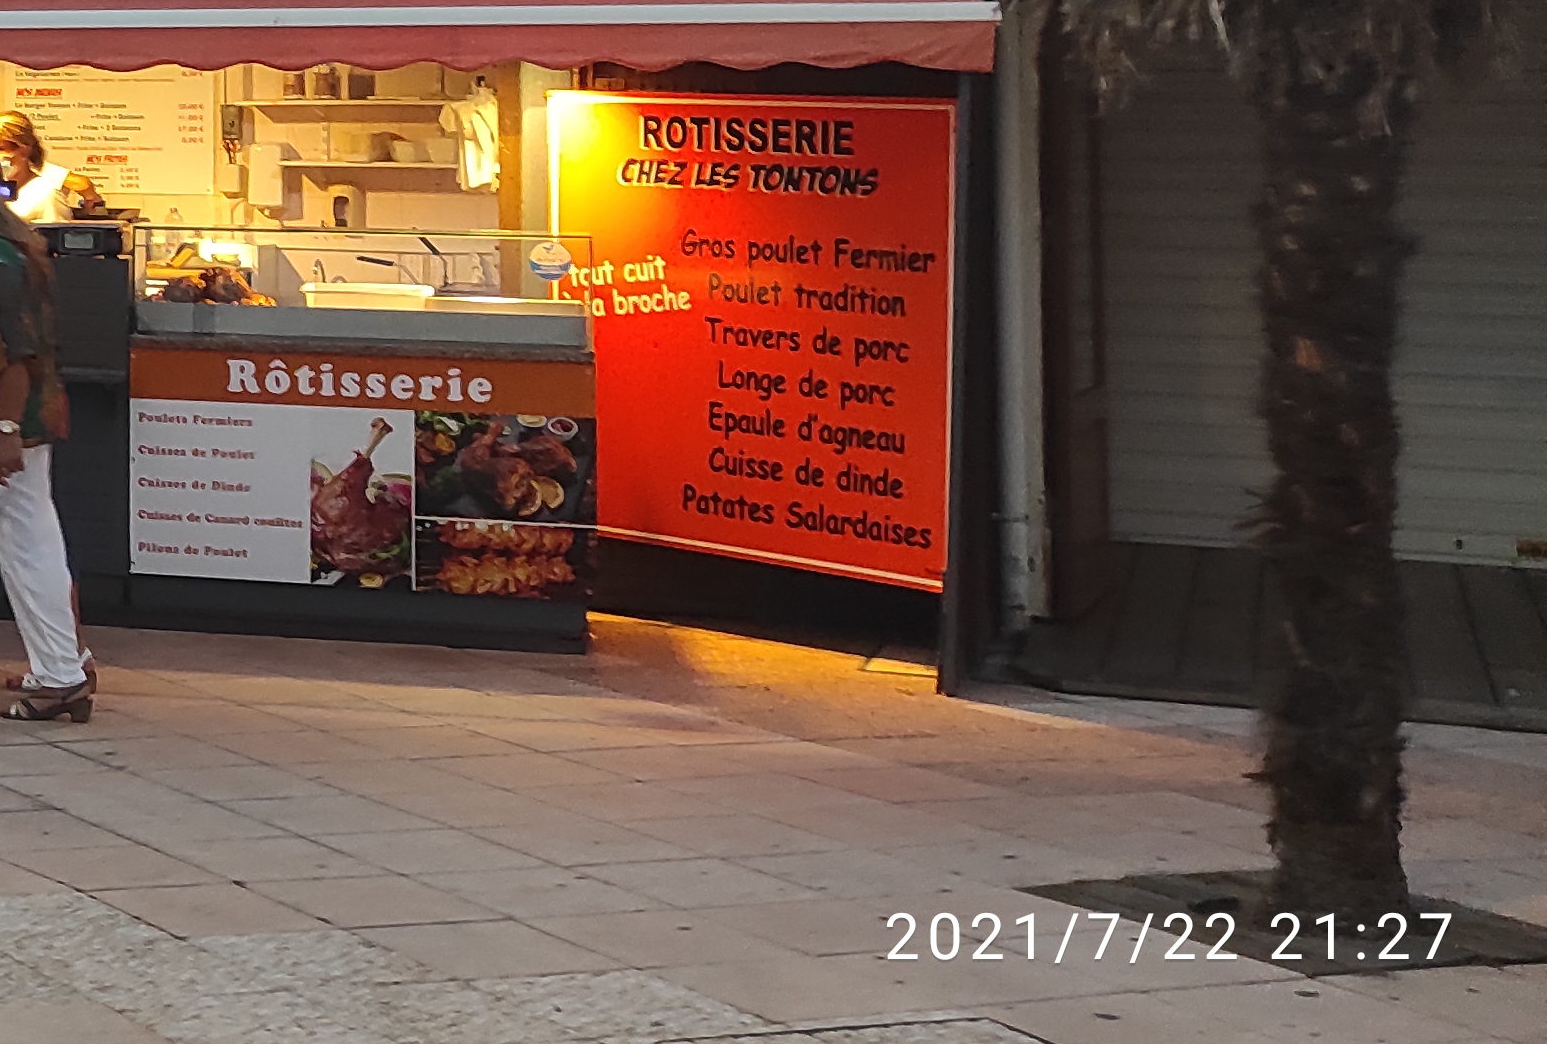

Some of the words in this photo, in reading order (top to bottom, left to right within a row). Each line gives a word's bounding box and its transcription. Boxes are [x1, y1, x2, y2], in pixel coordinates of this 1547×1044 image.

[640, 116, 855, 156] ROTISSERIE
[618, 159, 686, 187] CHEZ
[692, 161, 745, 189] LES
[750, 164, 879, 196] TONTONS
[623, 255, 666, 283] cuit
[681, 229, 736, 258] Gros
[748, 234, 822, 268] poulet
[835, 238, 936, 274] Fermier
[612, 284, 692, 317] broche
[709, 274, 782, 306] Poulet
[796, 278, 906, 317] tradition
[705, 317, 800, 353] Travers
[812, 327, 840, 357] de
[854, 337, 910, 367] porc
[225, 357, 493, 404] Rôtisserie
[718, 361, 787, 401] Longe
[798, 370, 828, 400] de
[840, 380, 895, 410] porc
[709, 402, 785, 440] Epaule
[798, 412, 905, 455] d'agneau
[709, 448, 783, 483] Cuisse
[795, 457, 824, 487] de
[837, 463, 903, 499] dinde
[683, 484, 774, 525] Patates
[786, 502, 932, 550] Salardaises
